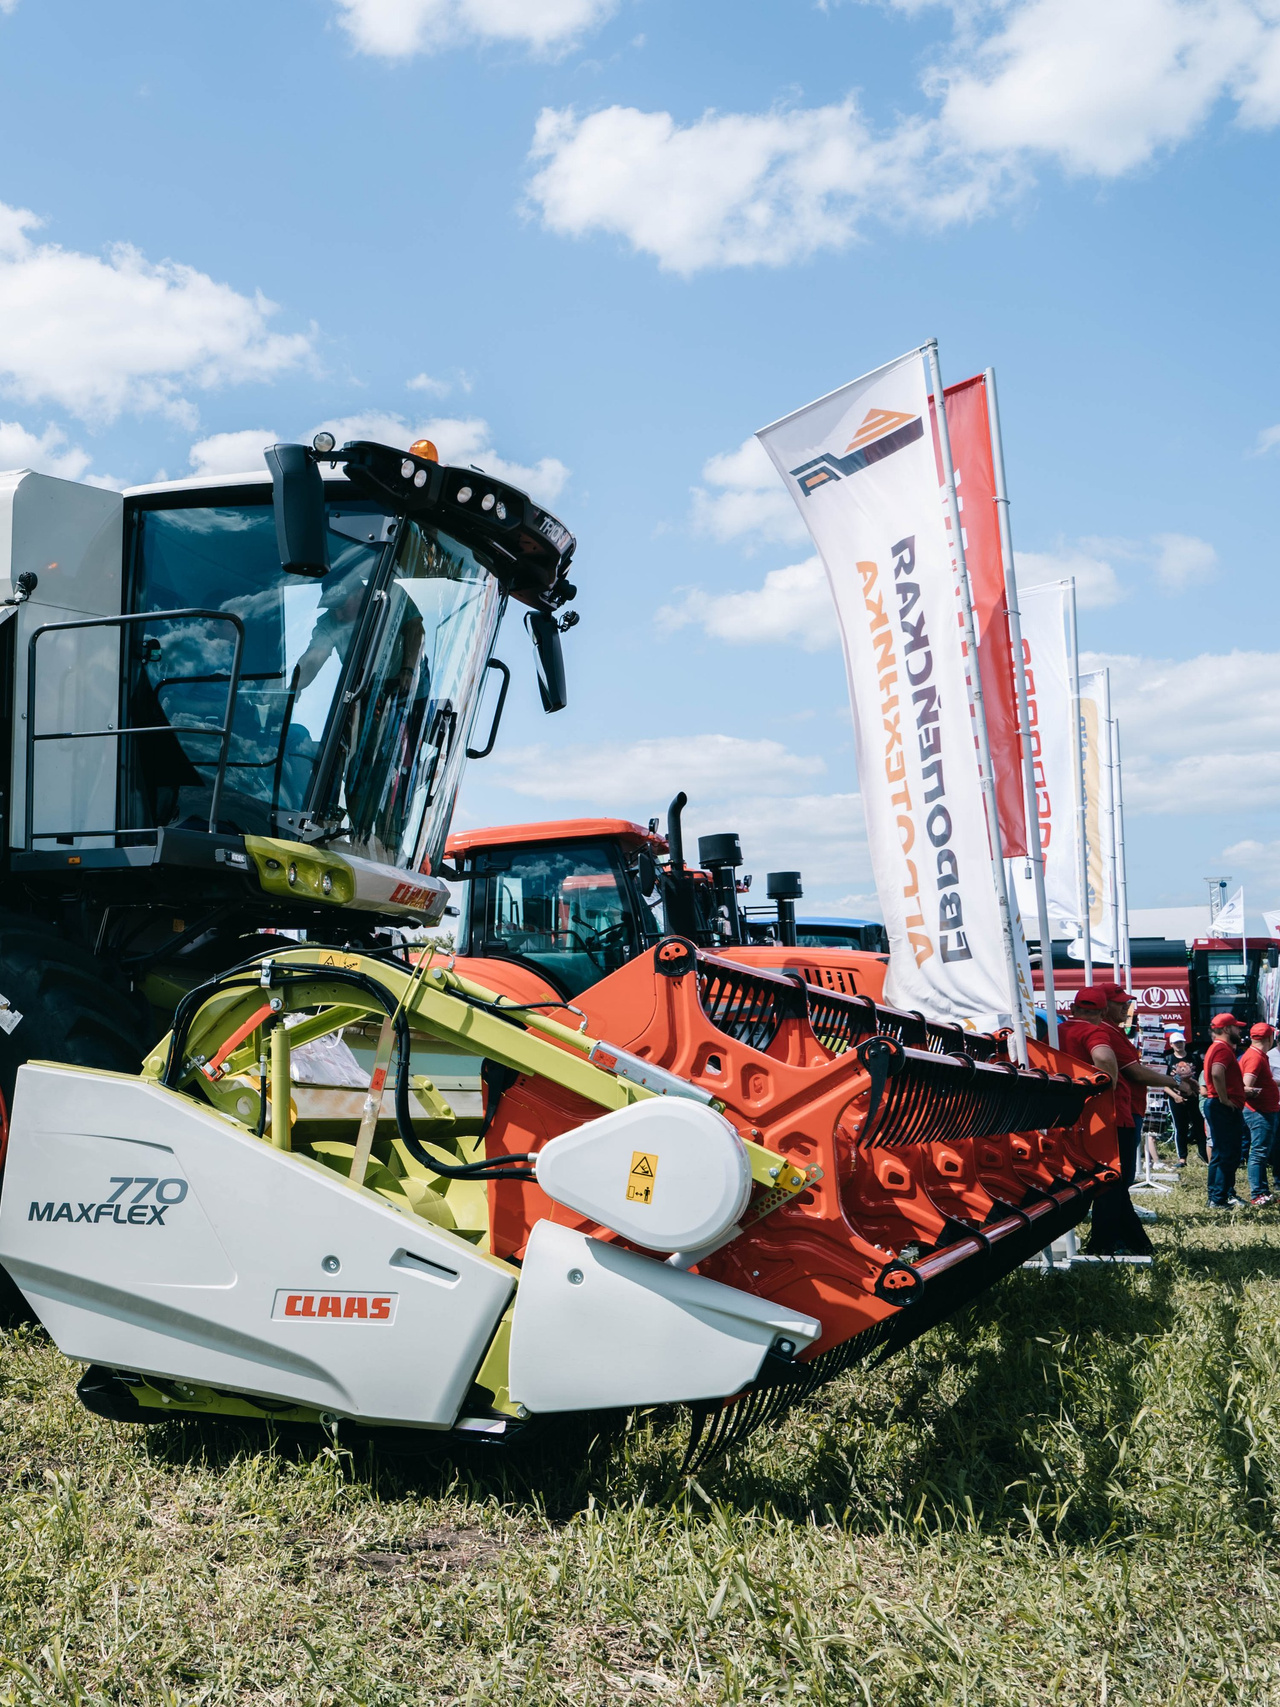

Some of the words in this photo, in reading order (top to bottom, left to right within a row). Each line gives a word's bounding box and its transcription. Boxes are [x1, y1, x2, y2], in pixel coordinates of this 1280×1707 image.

[388, 883, 438, 910] CLAAS
[106, 1176, 189, 1205] 770
[28, 1201, 170, 1226] MAXFLEX
[284, 1295, 391, 1319] CLAAS
